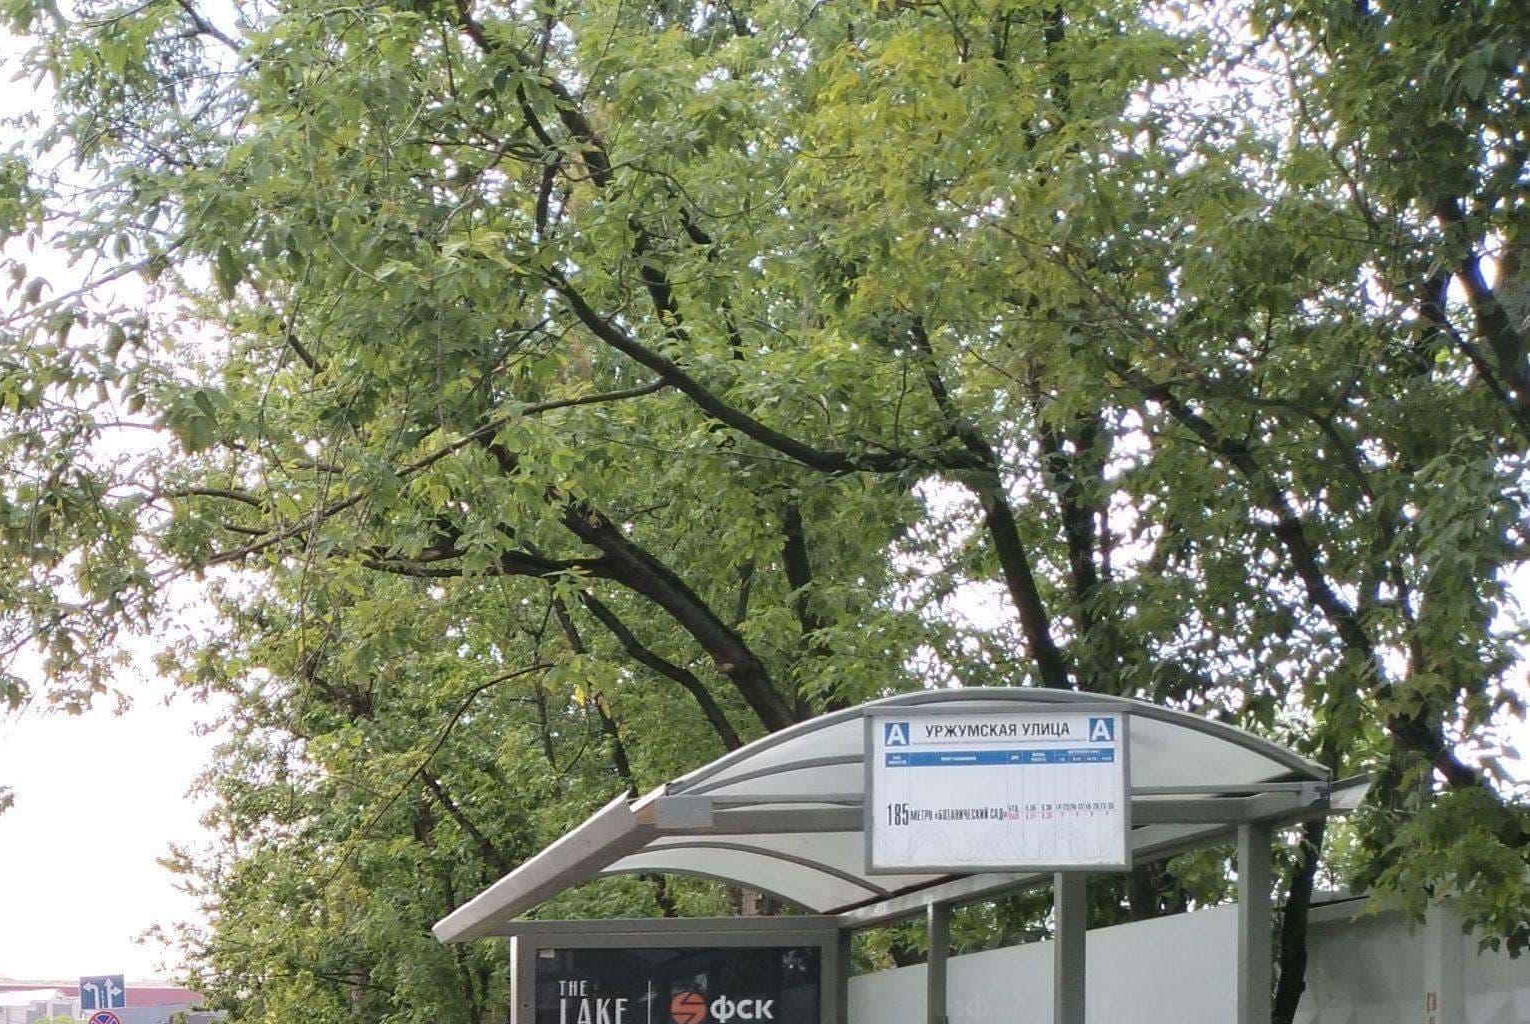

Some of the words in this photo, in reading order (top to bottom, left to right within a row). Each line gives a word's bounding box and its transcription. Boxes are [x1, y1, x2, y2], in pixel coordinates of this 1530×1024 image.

[925, 724, 1017, 738] УРЖУМСКАЯ
[1022, 722, 1070, 737] УЛИЦА
[887, 803, 909, 826] 185
[910, 809, 932, 821] МЕТРО
[558, 980, 587, 996] THE
